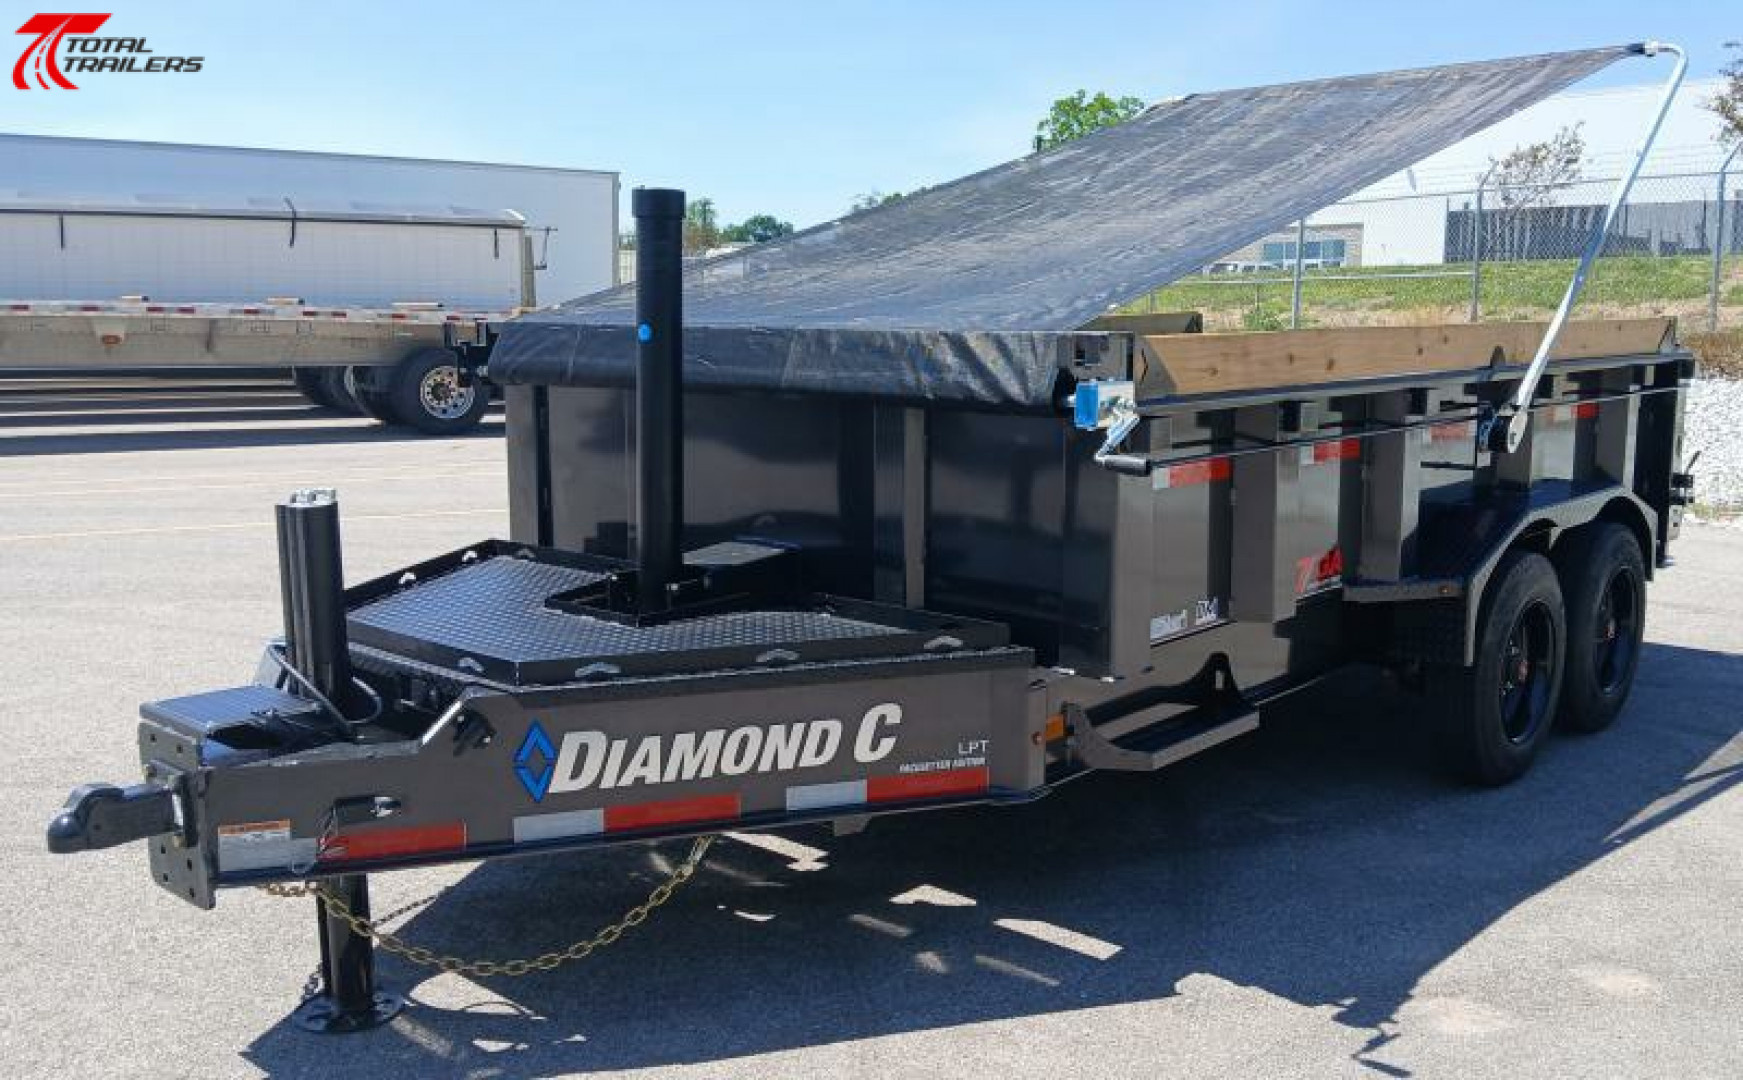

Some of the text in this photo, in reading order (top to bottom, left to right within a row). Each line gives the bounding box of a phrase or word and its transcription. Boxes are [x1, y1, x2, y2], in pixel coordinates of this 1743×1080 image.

[547, 702, 903, 794] DIAMOND C
[958, 739, 990, 755] LPT
